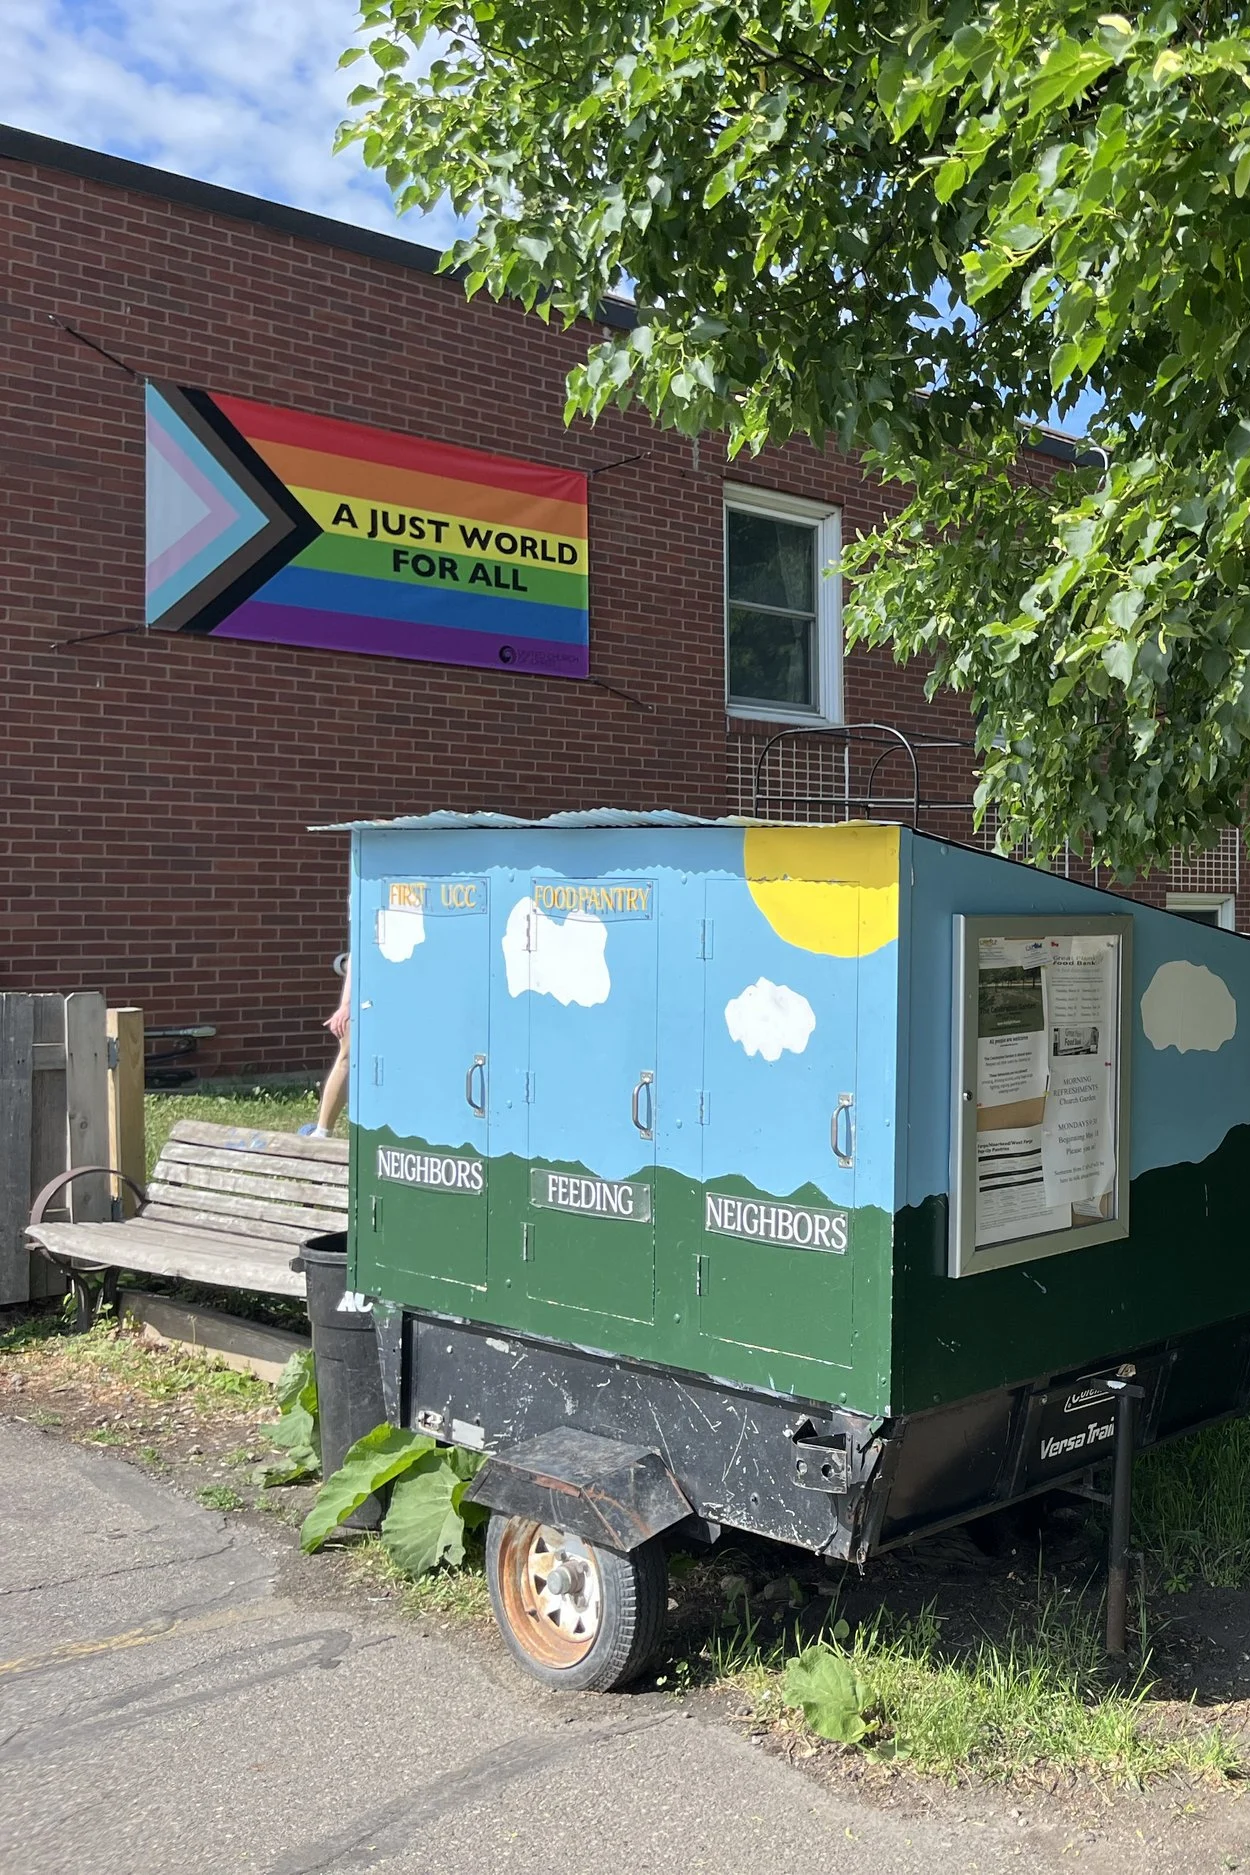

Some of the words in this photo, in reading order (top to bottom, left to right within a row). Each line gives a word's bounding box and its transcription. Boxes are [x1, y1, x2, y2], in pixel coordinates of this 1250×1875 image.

[332, 503, 358, 529] A
[367, 508, 449, 543] JUST
[459, 524, 578, 566] WORLD
[393, 549, 459, 581] FOR
[468, 563, 528, 592] ALL
[389, 882, 428, 907] FIRST
[440, 884, 477, 909] UCC
[1053, 1084, 1099, 1097] REFRESHMENTS
[1063, 1075, 1092, 1085] MORNING
[1059, 1096, 1079, 1106] Church
[1079, 1094, 1096, 1103] Garden
[1058, 1120, 1089, 1130] MONDAYS
[1058, 1135, 1085, 1144] Beginning
[377, 1149, 484, 1191] NEIGHBORS
[547, 1173, 634, 1215] FEEDING
[706, 1195, 848, 1250] NEIGHBORS
[1040, 1432, 1087, 1460] Versa
[1086, 1416, 1115, 1445] Trai
